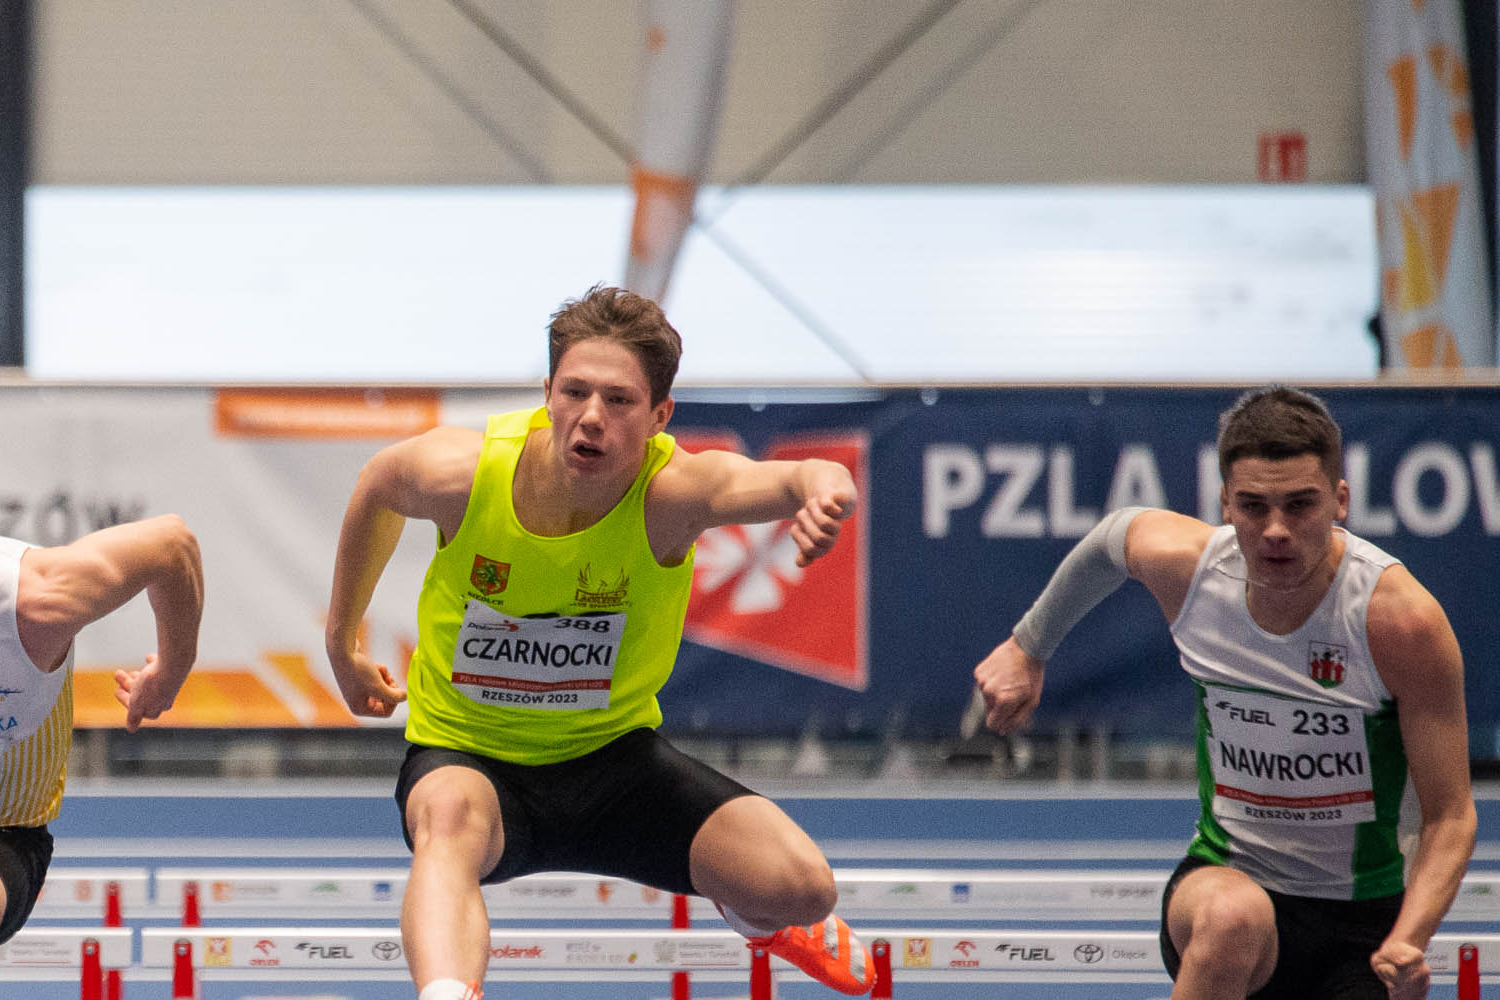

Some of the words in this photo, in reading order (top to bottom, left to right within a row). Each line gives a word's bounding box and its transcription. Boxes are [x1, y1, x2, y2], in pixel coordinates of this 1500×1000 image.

[553, 618, 611, 634] 388
[462, 637, 613, 668] CZARNOCKI
[481, 689, 545, 704] RZESZÓW
[547, 692, 579, 704] 2023
[1229, 707, 1276, 727] FUEL
[1292, 709, 1350, 736] 233
[1220, 740, 1364, 781] NAWROCKI
[1245, 806, 1306, 821] RZESZÓW
[1310, 809, 1342, 821] 2023
[308, 946, 354, 960] FUEL
[1009, 947, 1055, 962] FUEL
